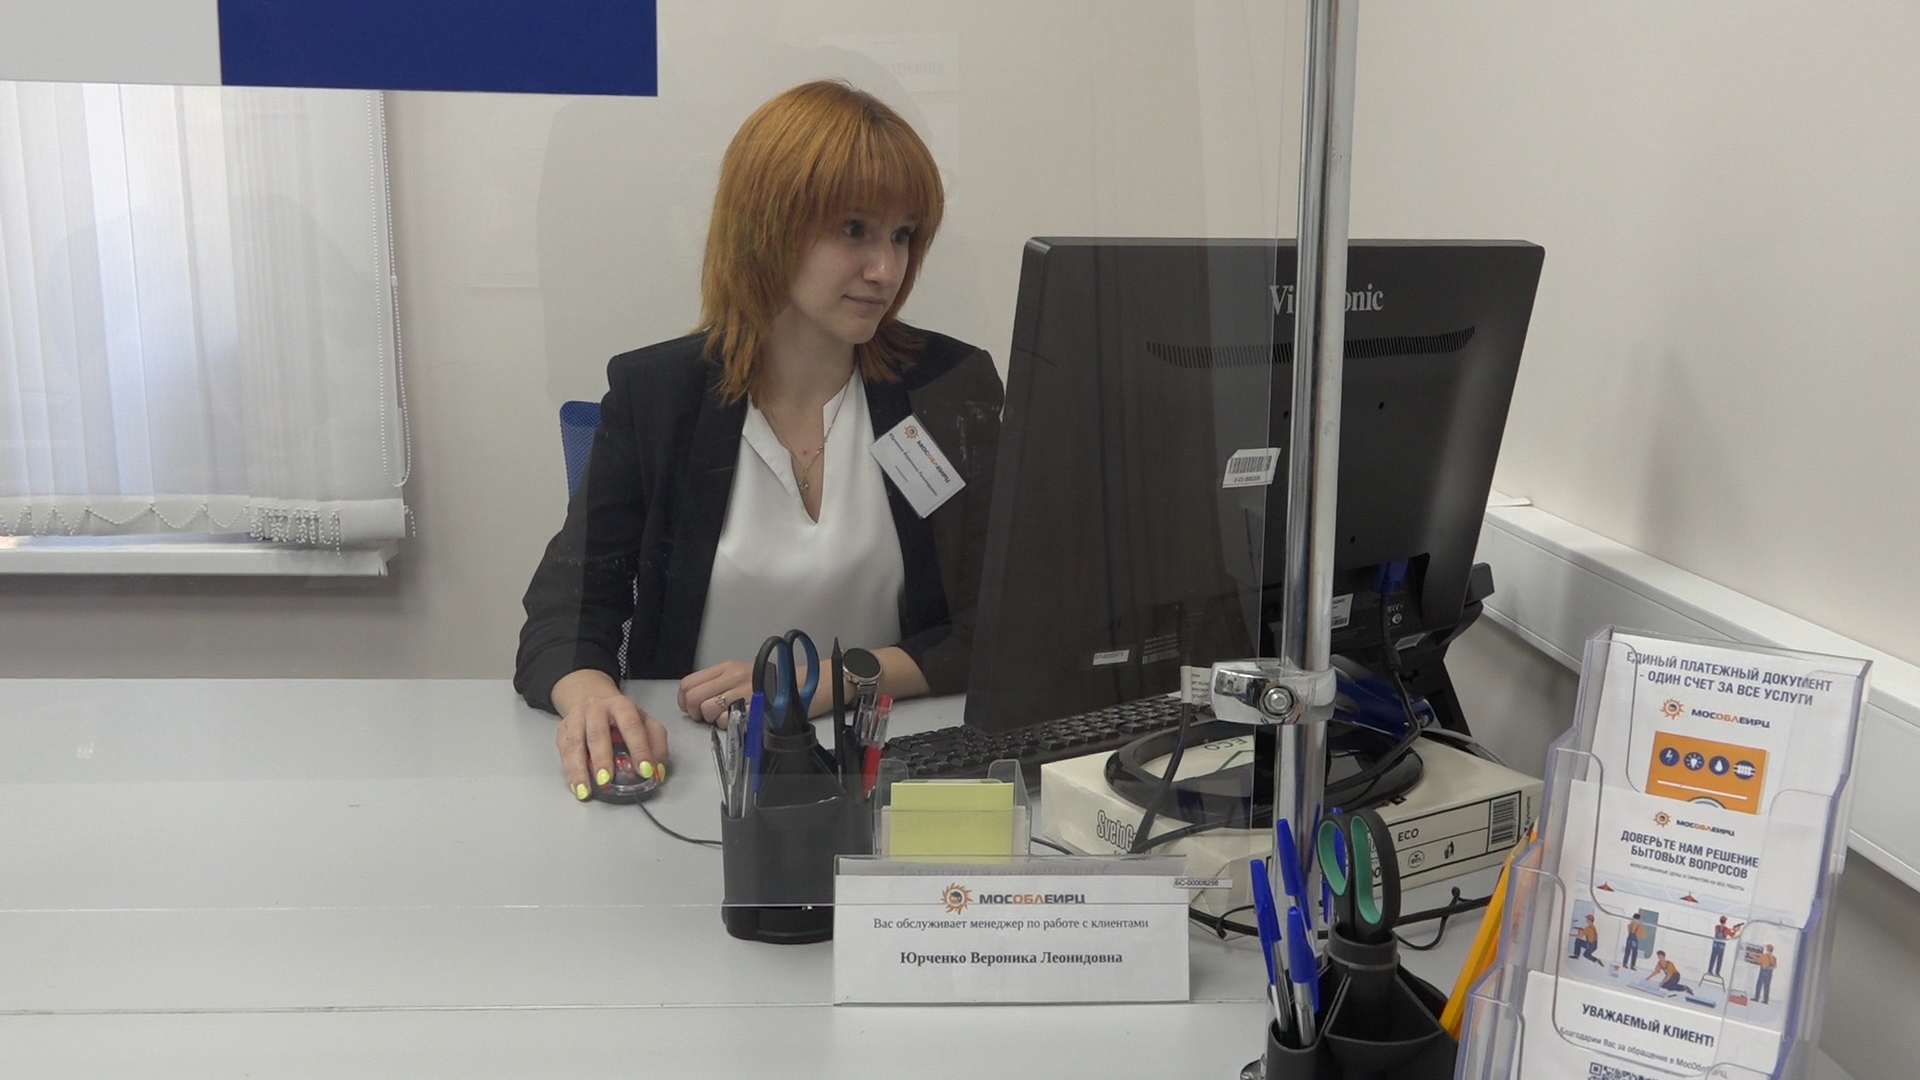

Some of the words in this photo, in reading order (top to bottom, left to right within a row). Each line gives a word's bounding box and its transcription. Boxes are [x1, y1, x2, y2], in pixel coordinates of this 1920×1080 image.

[1269, 283, 1384, 315] Vionic
[1626, 651, 1677, 669] ЕДИНЫЙ
[1680, 659, 1759, 681] ПЛАТЕЖНЫЙ
[1762, 671, 1833, 692] ДОКУМЕНТ
[1648, 671, 1681, 686] ОДИН
[1684, 676, 1715, 691] СЧЕТ
[1717, 681, 1733, 695] ЗА
[1737, 685, 1760, 698] ВСЕ
[1764, 689, 1813, 706] УСЛУГИ
[1691, 709, 1771, 728] МОСОБЛЕИРЦ
[1097, 809, 1137, 853] SvetoC
[1398, 828, 1419, 842] ECO
[1676, 820, 1735, 837] МОСОБЛЕИРЦ
[1621, 830, 1676, 851] ДОВЕРЬТЕ
[1679, 842, 1703, 856] НАМ
[1706, 847, 1759, 868] РЕШЕНИЕ
[1630, 845, 1686, 866] БЫТОВЫХ
[1688, 857, 1748, 879] ВОПРОСОВ
[978, 894, 1086, 905] МОСОБЛЕИРЦ
[873, 918, 893, 929] Вас
[896, 918, 967, 931] обслуживает
[970, 919, 1024, 931] менеджер
[1027, 920, 1041, 929] по
[1043, 918, 1079, 931] работе
[1082, 920, 1089, 929] с
[1091, 920, 1149, 929] клиентами
[900, 951, 967, 966] Юрченко
[970, 951, 1037, 966] Вероника
[1040, 951, 1123, 965] Леонидовна
[1582, 1003, 1660, 1033] УВАЖАЕМЫЙ
[1663, 1025, 1715, 1048] КЛИЕНТ!
[1560, 1026, 1601, 1044] Благодарим
[1603, 1038, 1616, 1050] Вас
[1618, 1043, 1626, 1052] за
[1627, 1045, 1668, 1063] обращение
